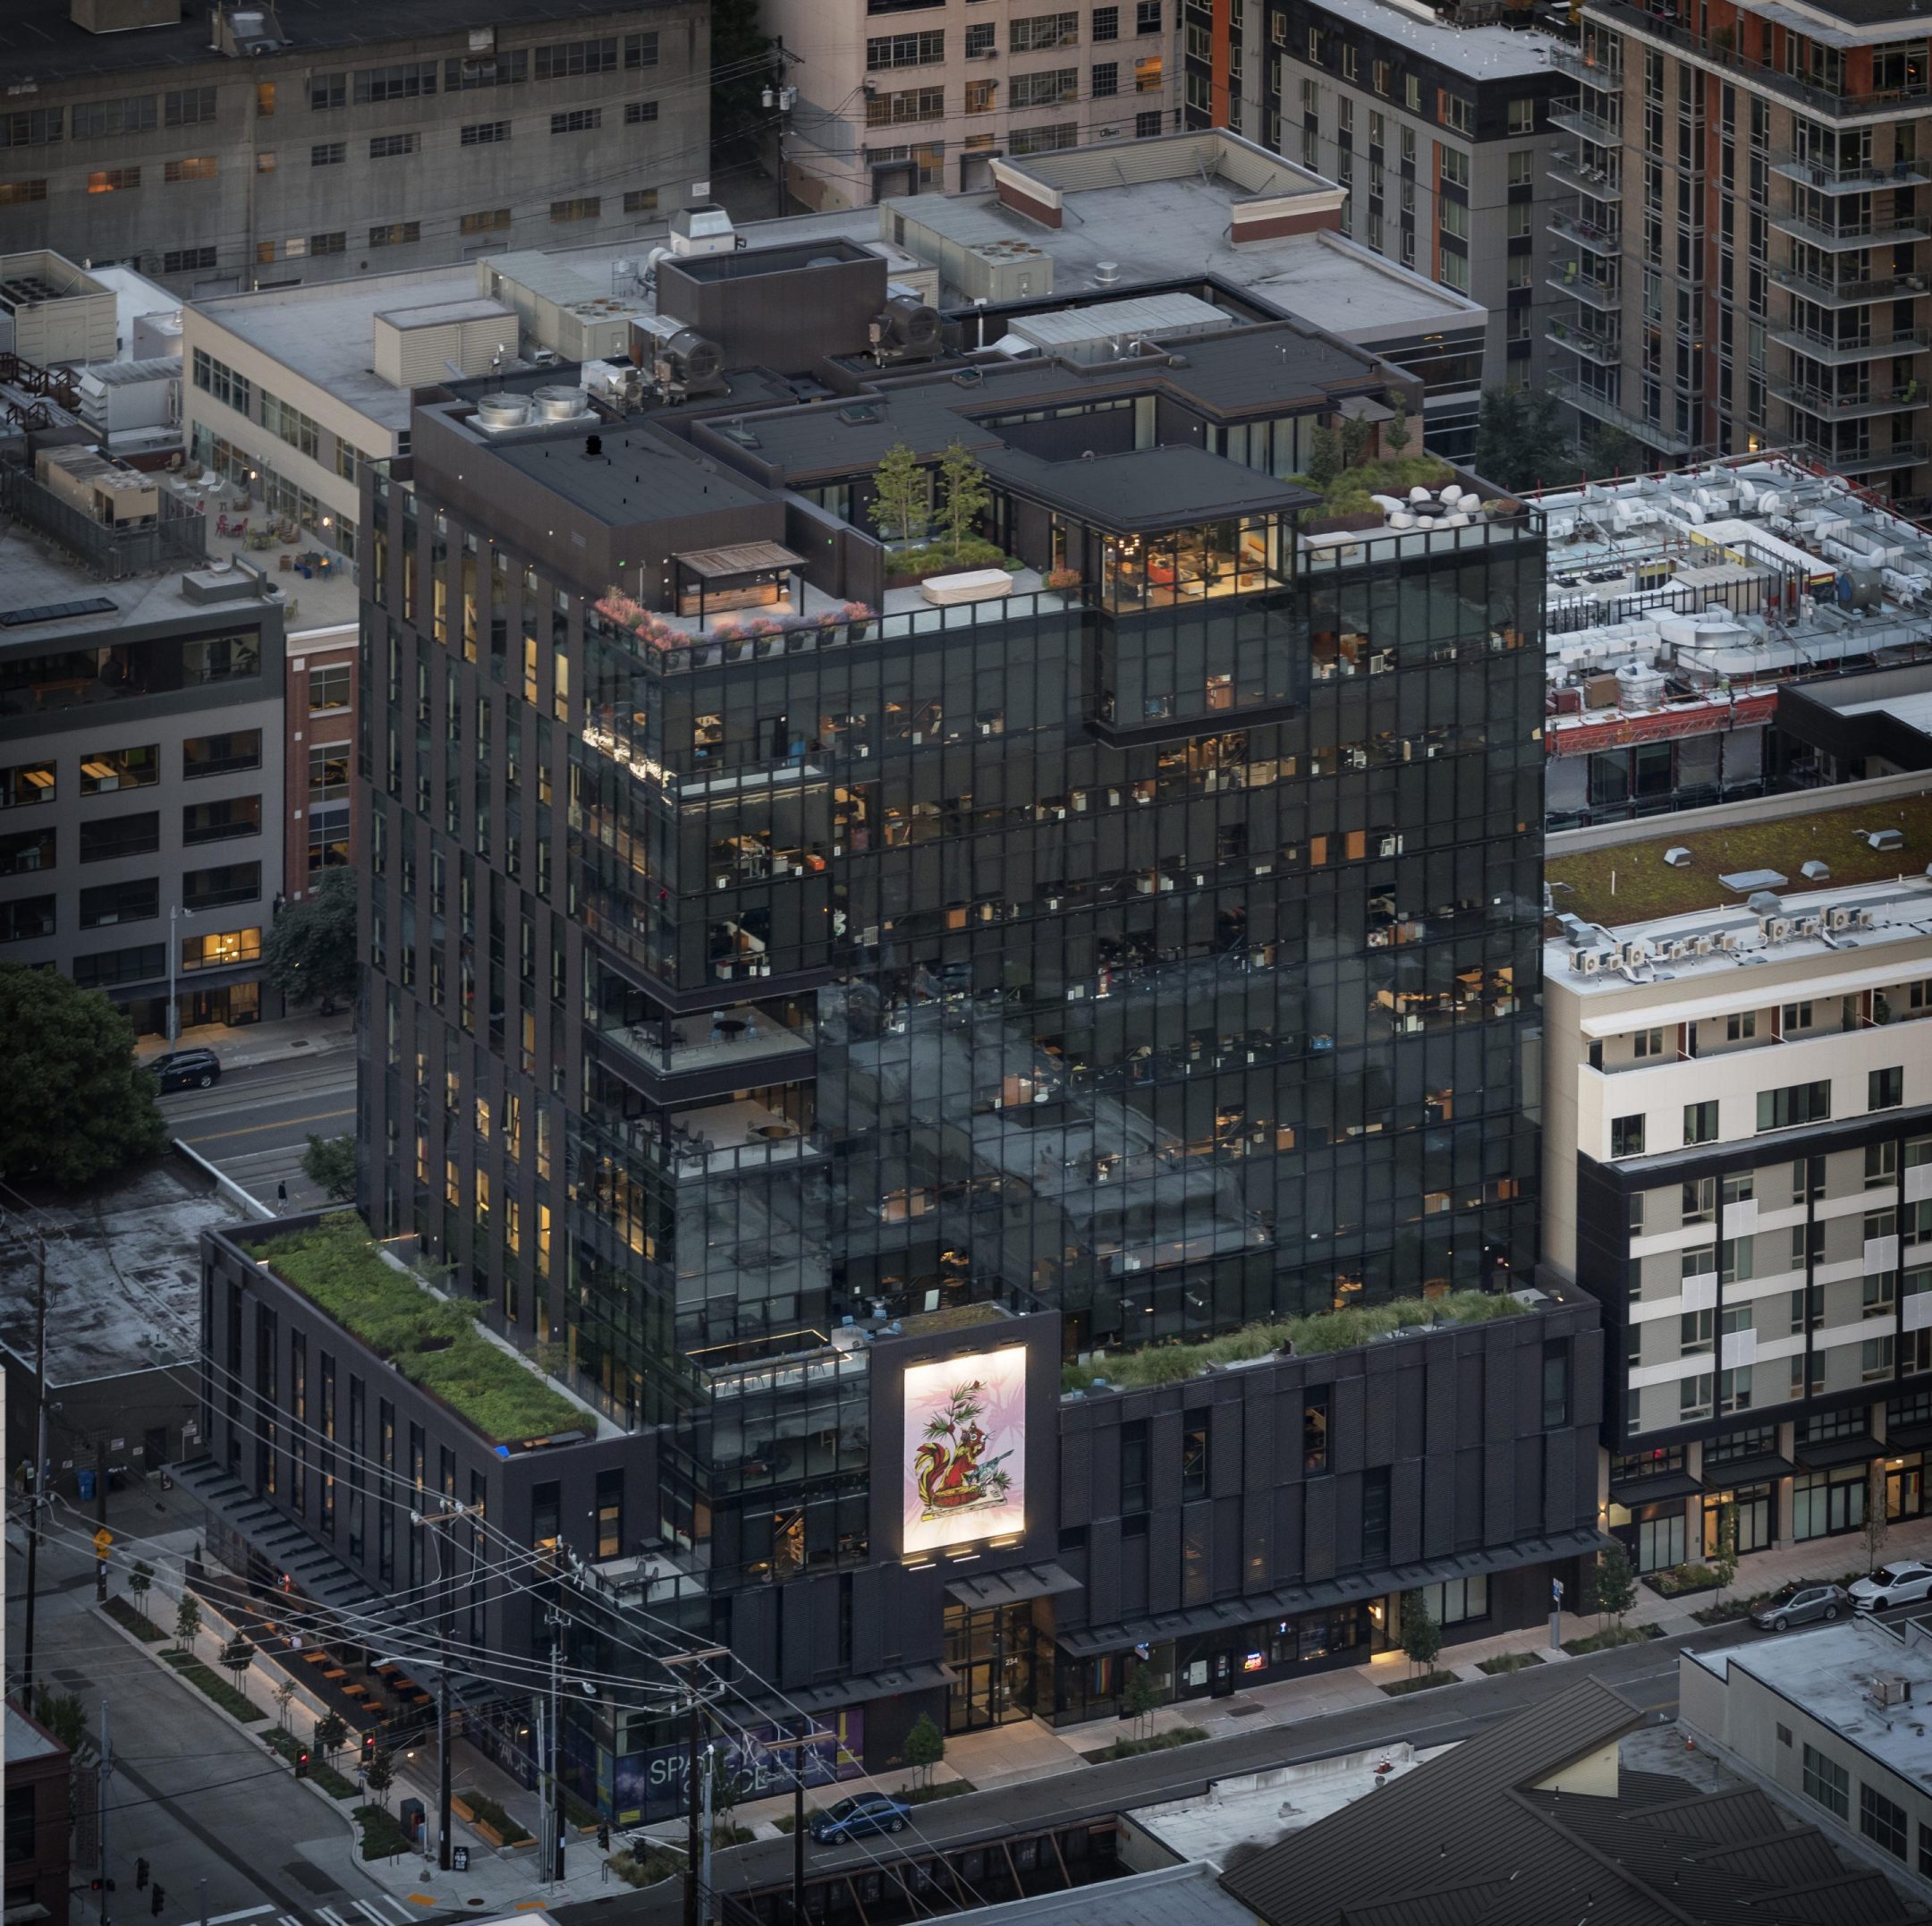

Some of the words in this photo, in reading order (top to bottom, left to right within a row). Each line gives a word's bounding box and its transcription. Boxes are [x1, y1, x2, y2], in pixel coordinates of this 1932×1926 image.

[1005, 1658, 1018, 1667] 234
[650, 1741, 754, 1785] SPAY
[682, 1764, 768, 1805] SCE
